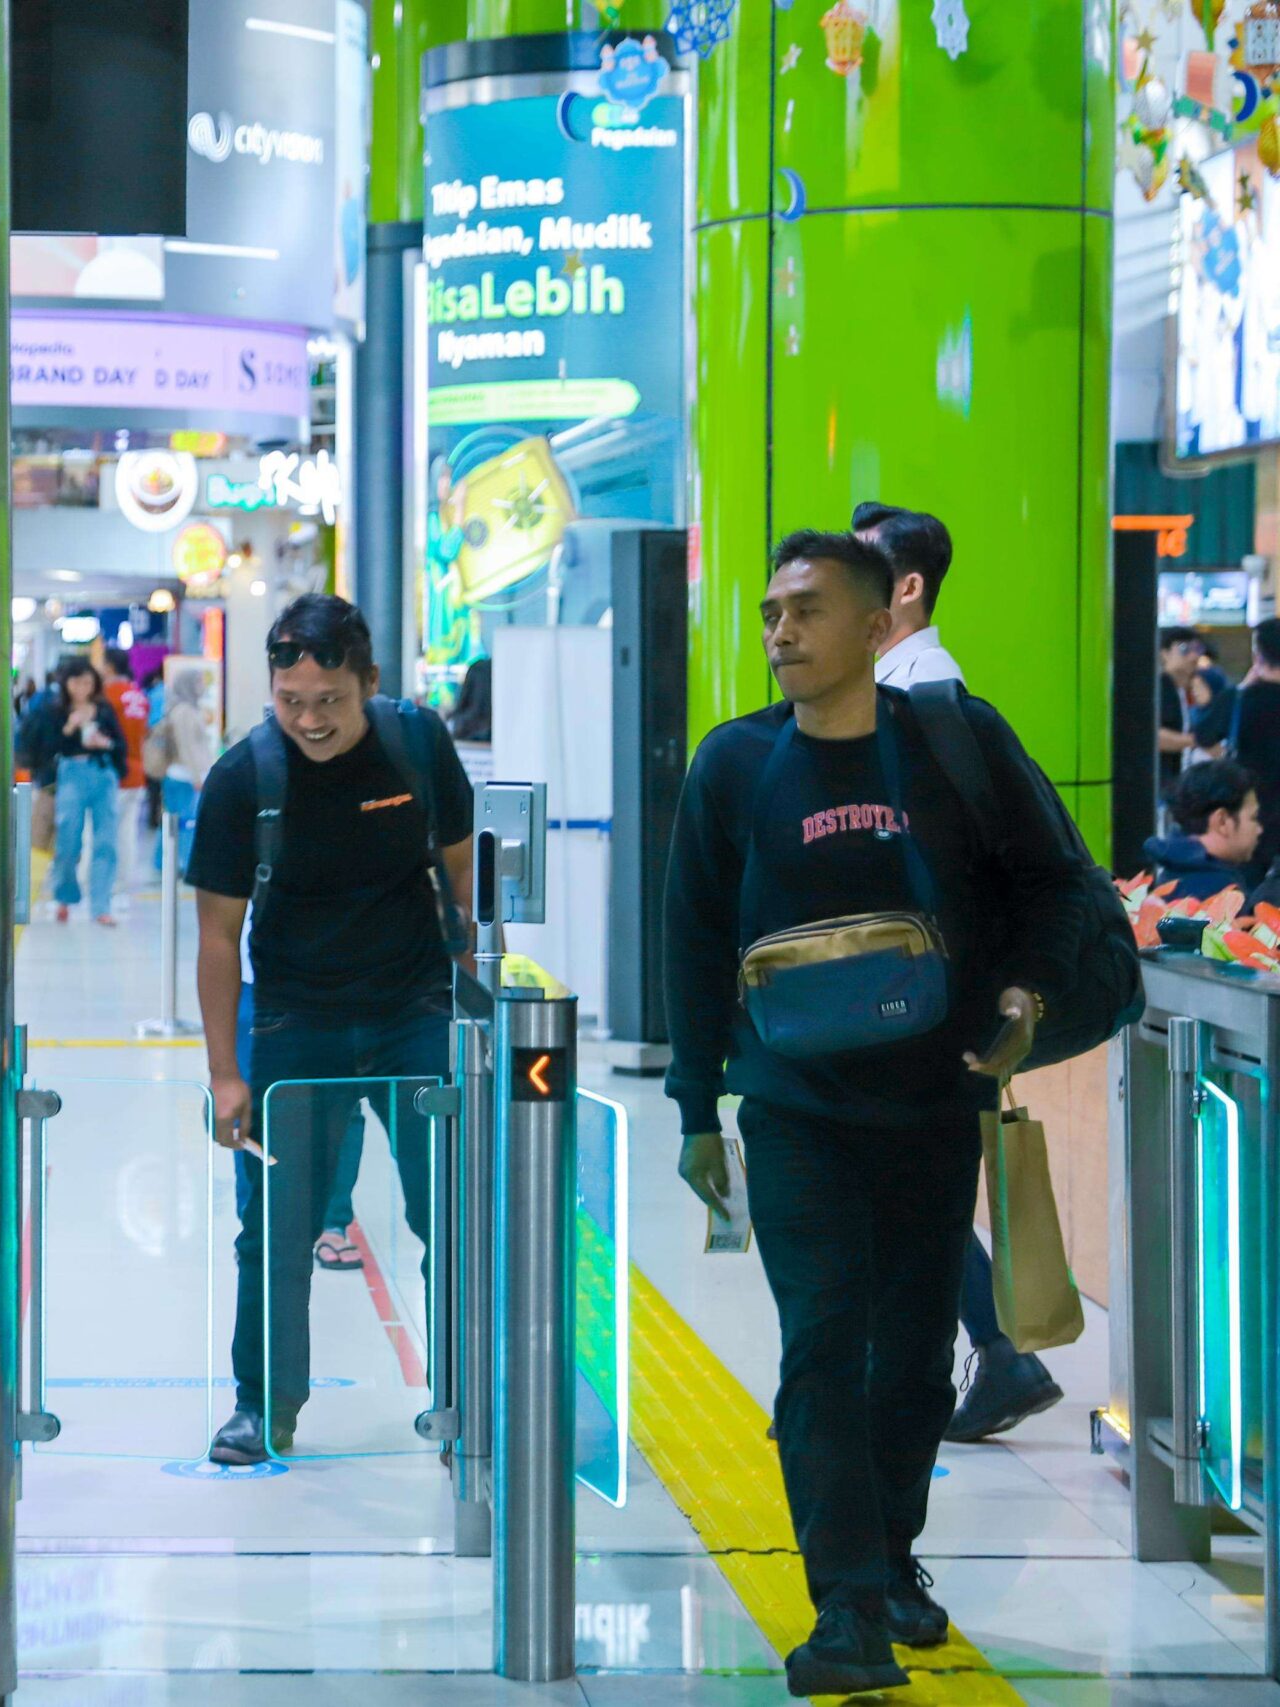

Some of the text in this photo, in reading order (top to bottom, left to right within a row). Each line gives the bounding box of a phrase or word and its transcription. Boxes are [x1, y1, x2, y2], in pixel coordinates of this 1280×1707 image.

[480, 175, 564, 210] Emas
[539, 213, 653, 251] Mudik
[437, 328, 546, 369] Nyaman
[93, 366, 138, 387] DAY
